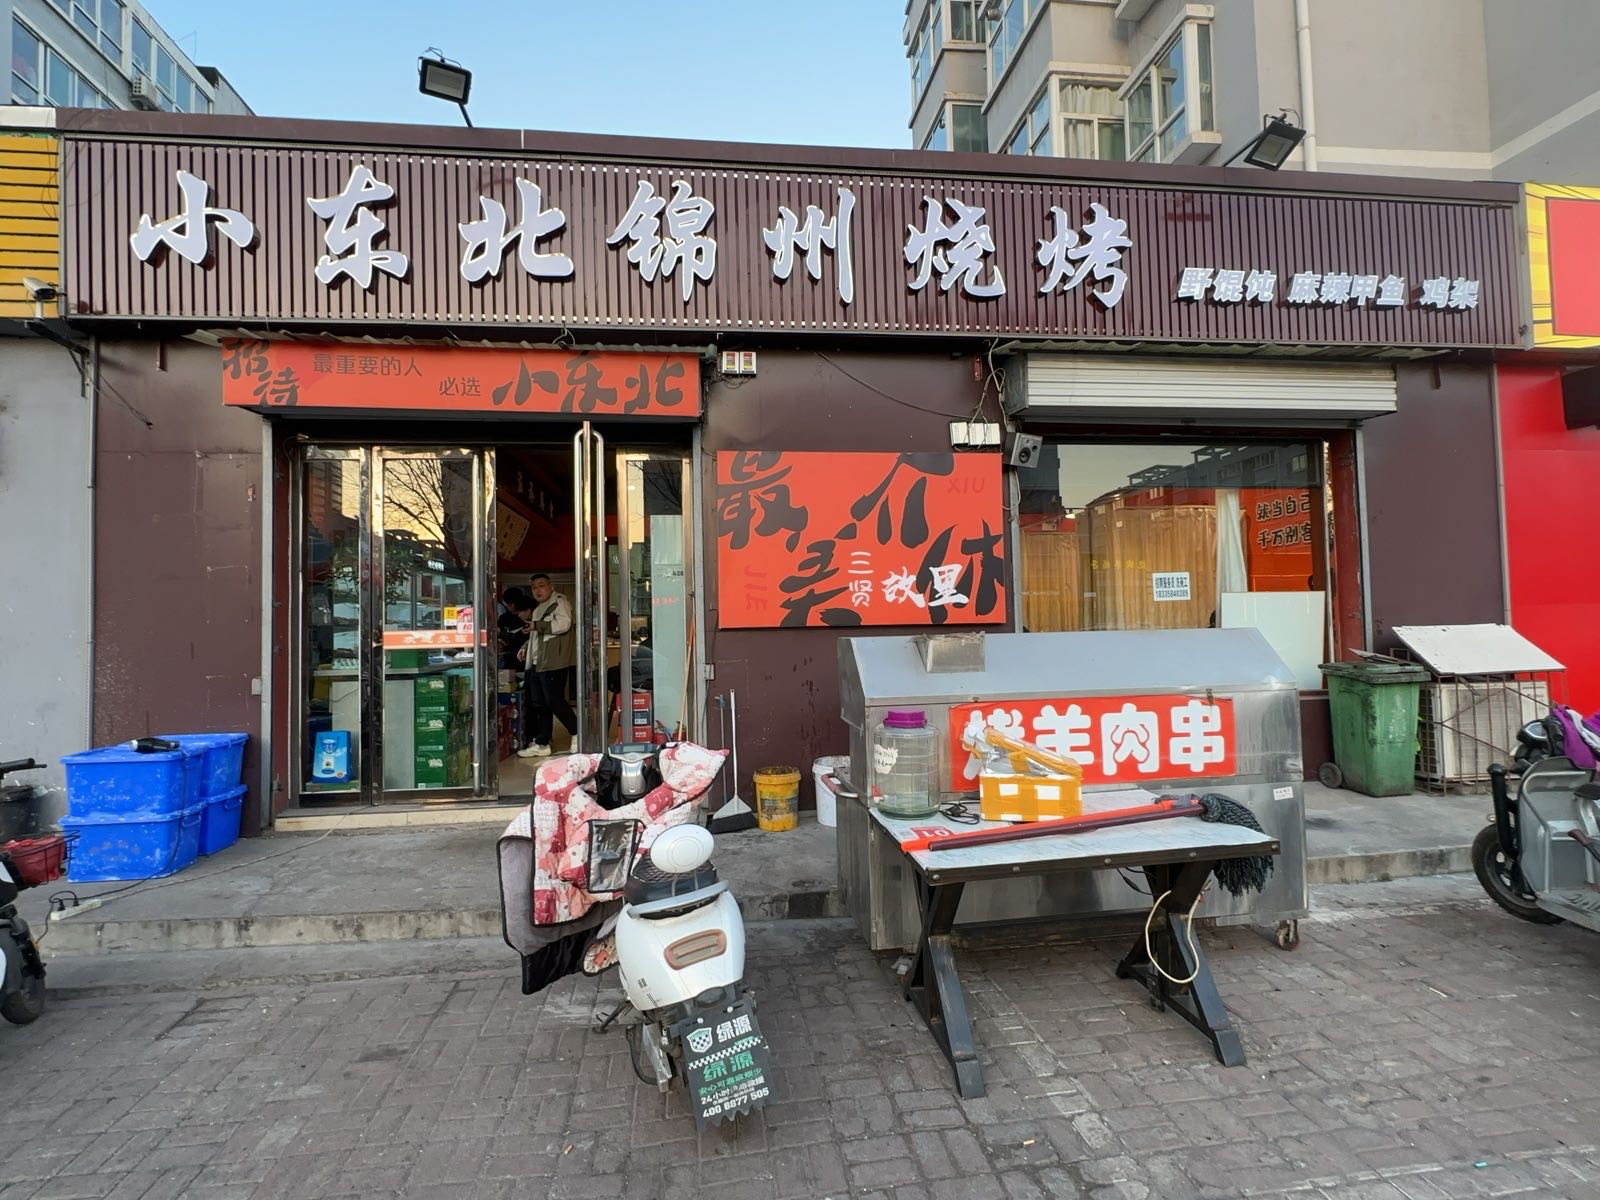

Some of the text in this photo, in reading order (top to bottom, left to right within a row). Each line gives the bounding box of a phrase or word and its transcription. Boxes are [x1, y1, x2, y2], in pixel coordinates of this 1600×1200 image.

[130, 164, 1133, 308] 小东北锦州烧烤
[1177, 267, 1479, 309] 野馄饨 麻辣甲鱼 鸡架
[312, 353, 423, 377] 最重要的人
[438, 376, 481, 397] 必选
[492, 351, 685, 413] 小东北
[1256, 493, 1311, 521] 就当自己
[881, 563, 970, 608] 故里
[716, 1014, 752, 1043] 绿源
[703, 1050, 754, 1082] 绿源
[702, 1104, 721, 1118] 400
[724, 1095, 748, 1111] 8877
[750, 1087, 770, 1101] 505
